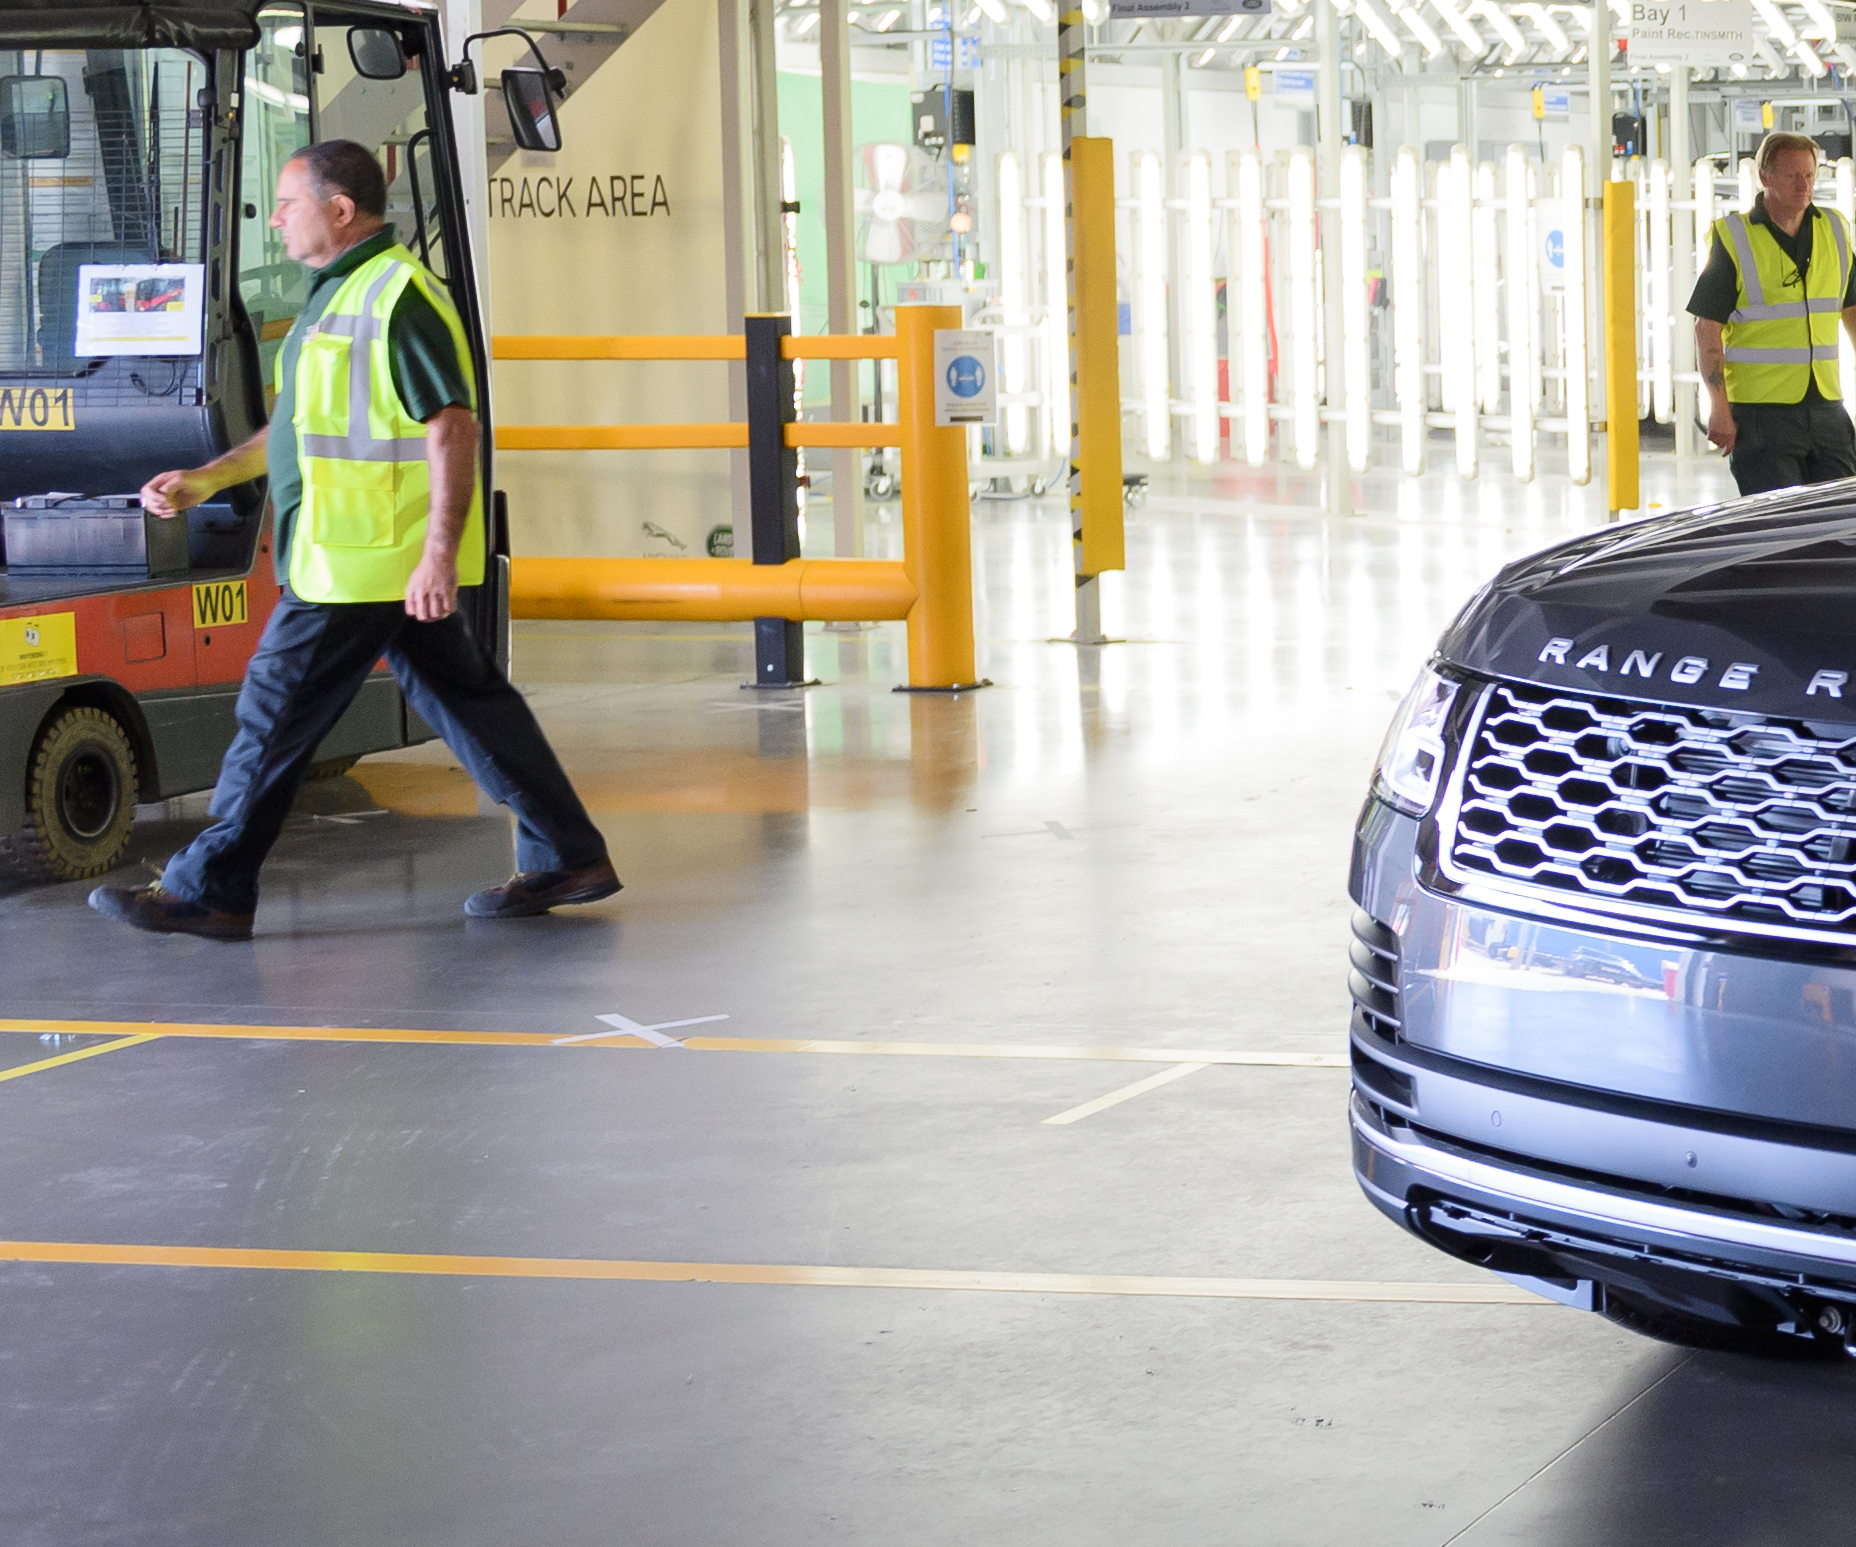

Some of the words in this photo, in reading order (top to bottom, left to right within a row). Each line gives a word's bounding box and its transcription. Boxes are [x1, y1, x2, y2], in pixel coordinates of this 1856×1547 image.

[1632, 4, 1669, 26] Bay
[1679, 4, 1686, 21] 1
[1632, 28, 1663, 39] Paint
[488, 175, 576, 218] TRACK
[586, 174, 670, 217] AREA
[196, 583, 245, 625] W01
[1538, 637, 1760, 691] RANGE
